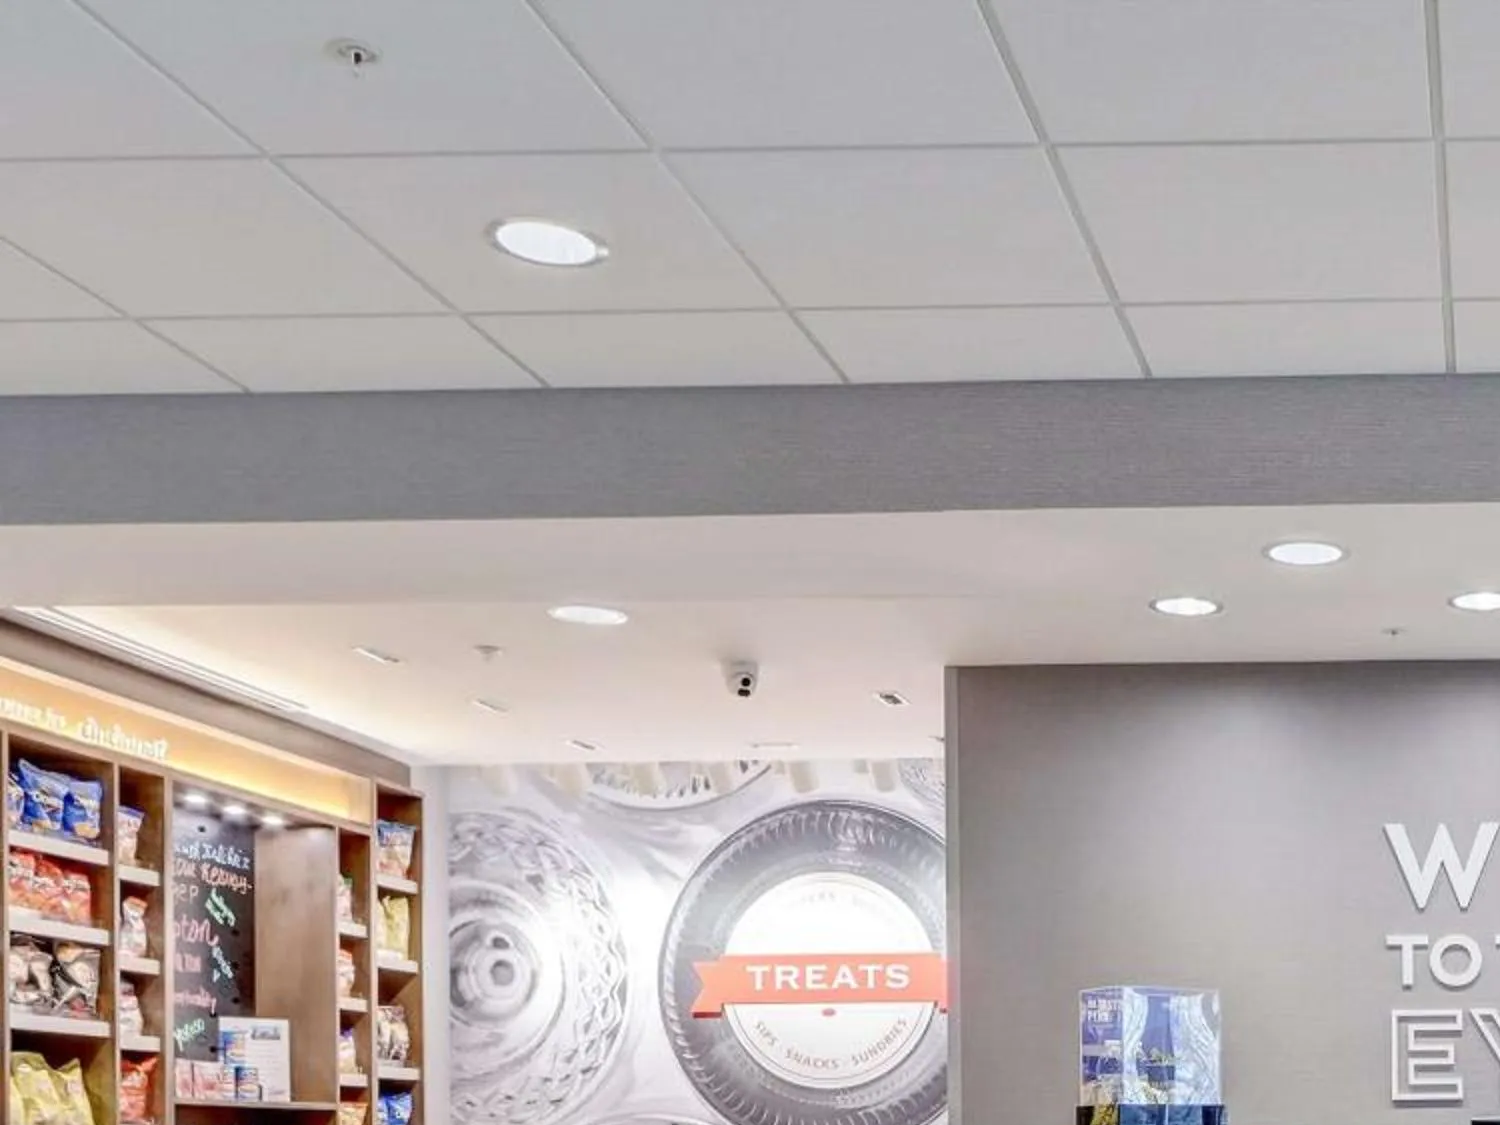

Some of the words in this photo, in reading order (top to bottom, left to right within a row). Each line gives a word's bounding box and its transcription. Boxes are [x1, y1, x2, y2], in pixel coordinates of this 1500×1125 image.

[745, 963, 910, 991] TREATS
[1386, 934, 1483, 988] TO
[784, 1046, 840, 1070] SNACKS
[850, 1016, 908, 1067] SUNDRIES
